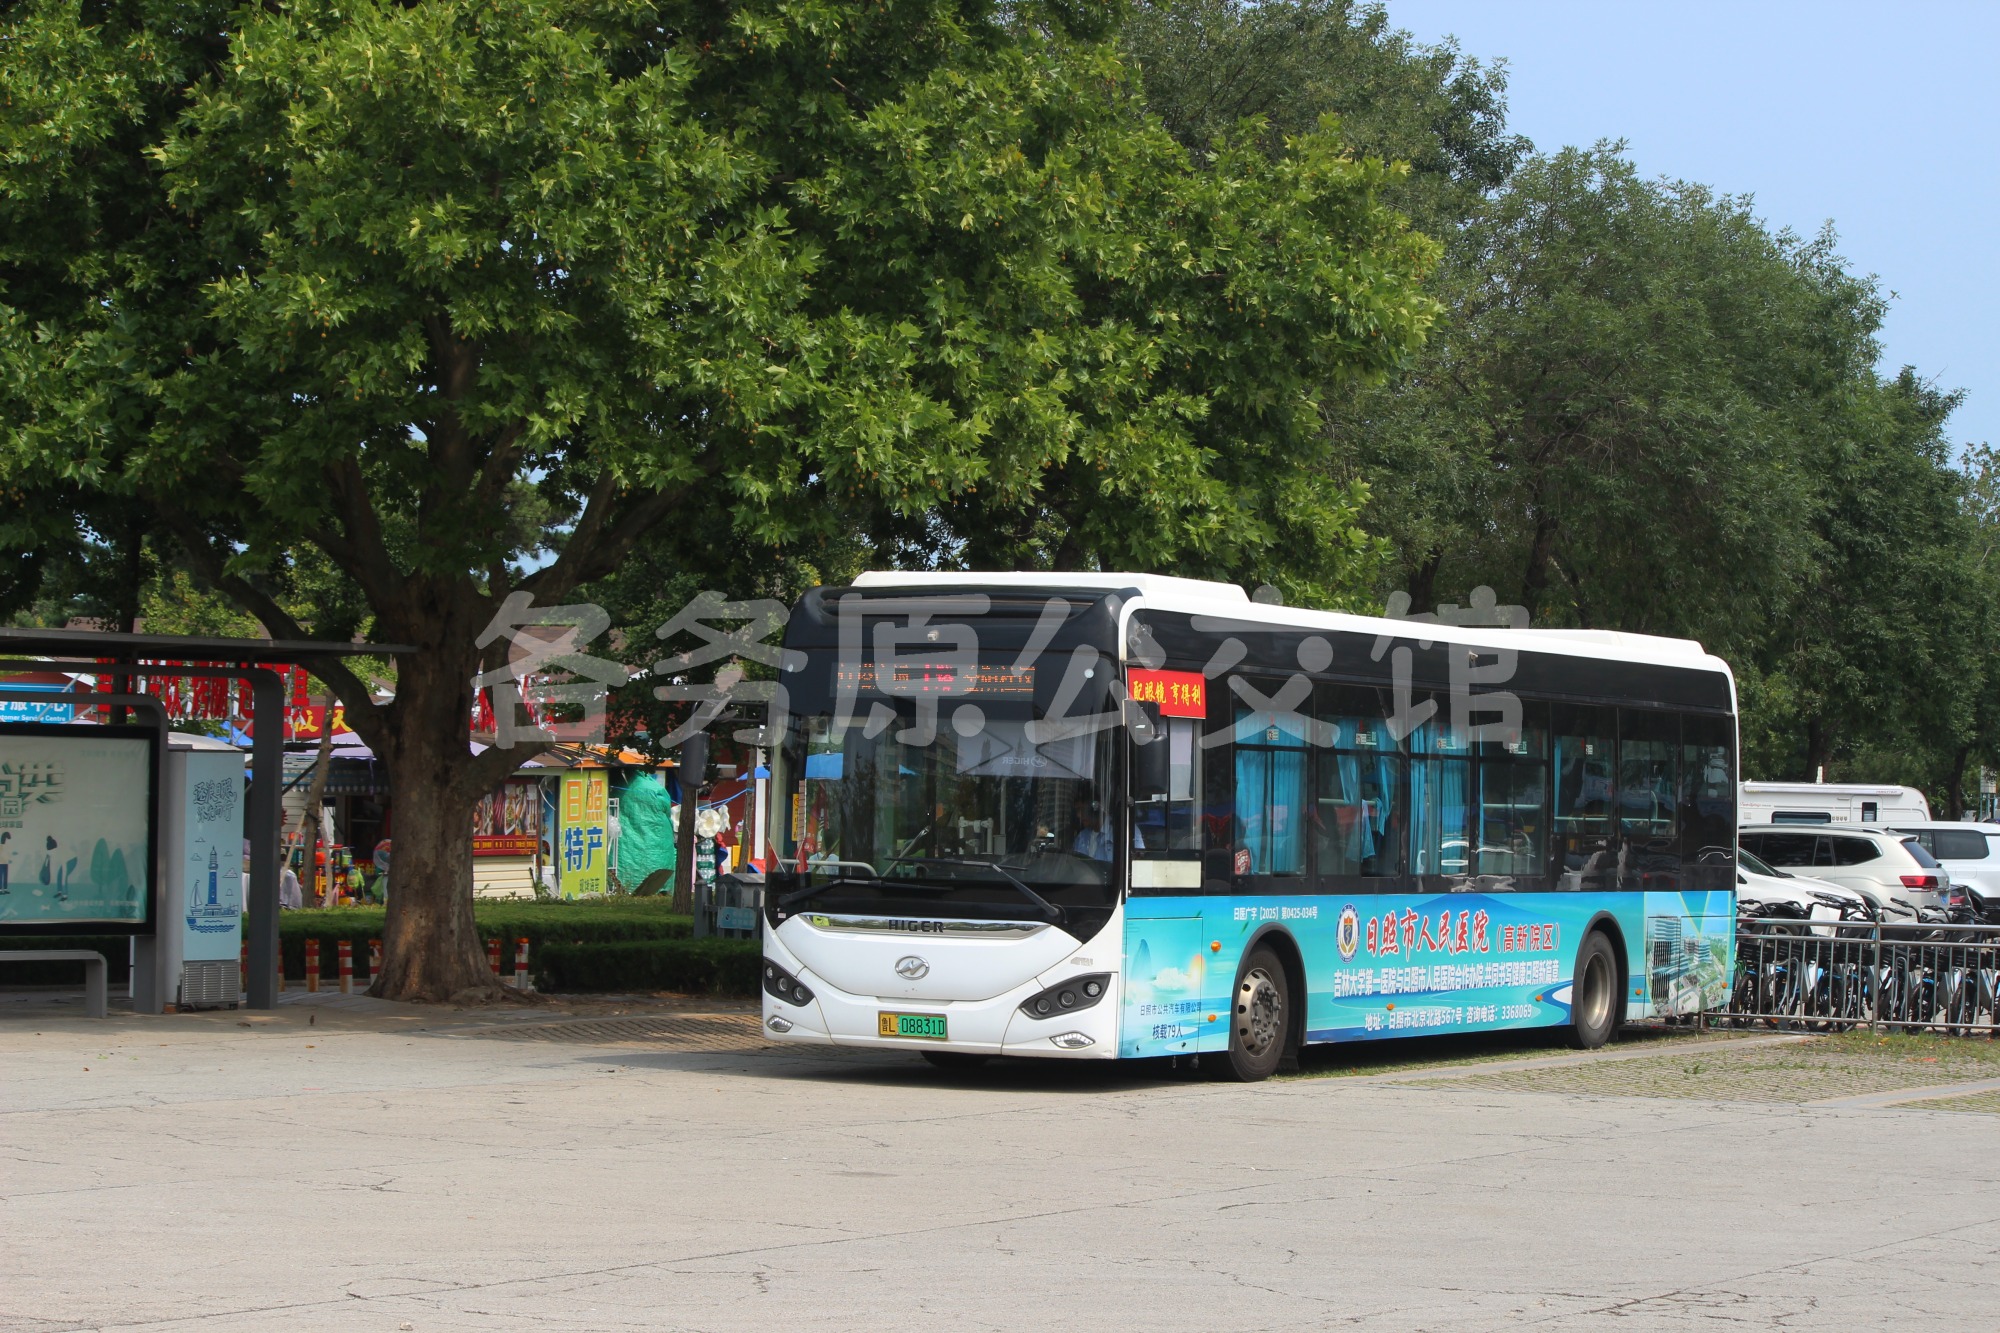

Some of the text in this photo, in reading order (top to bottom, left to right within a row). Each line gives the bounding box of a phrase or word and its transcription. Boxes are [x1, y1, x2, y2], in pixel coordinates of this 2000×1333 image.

[1133, 680, 1201, 706] 配眼镜 亨得利
[564, 826, 604, 873] 特产
[888, 919, 945, 934] HIGER
[1366, 907, 1490, 962] 日照市人民医院
[1140, 1001, 1203, 1016] 日照市公共汽车有限公司
[1152, 1023, 1183, 1040] 核载79人
